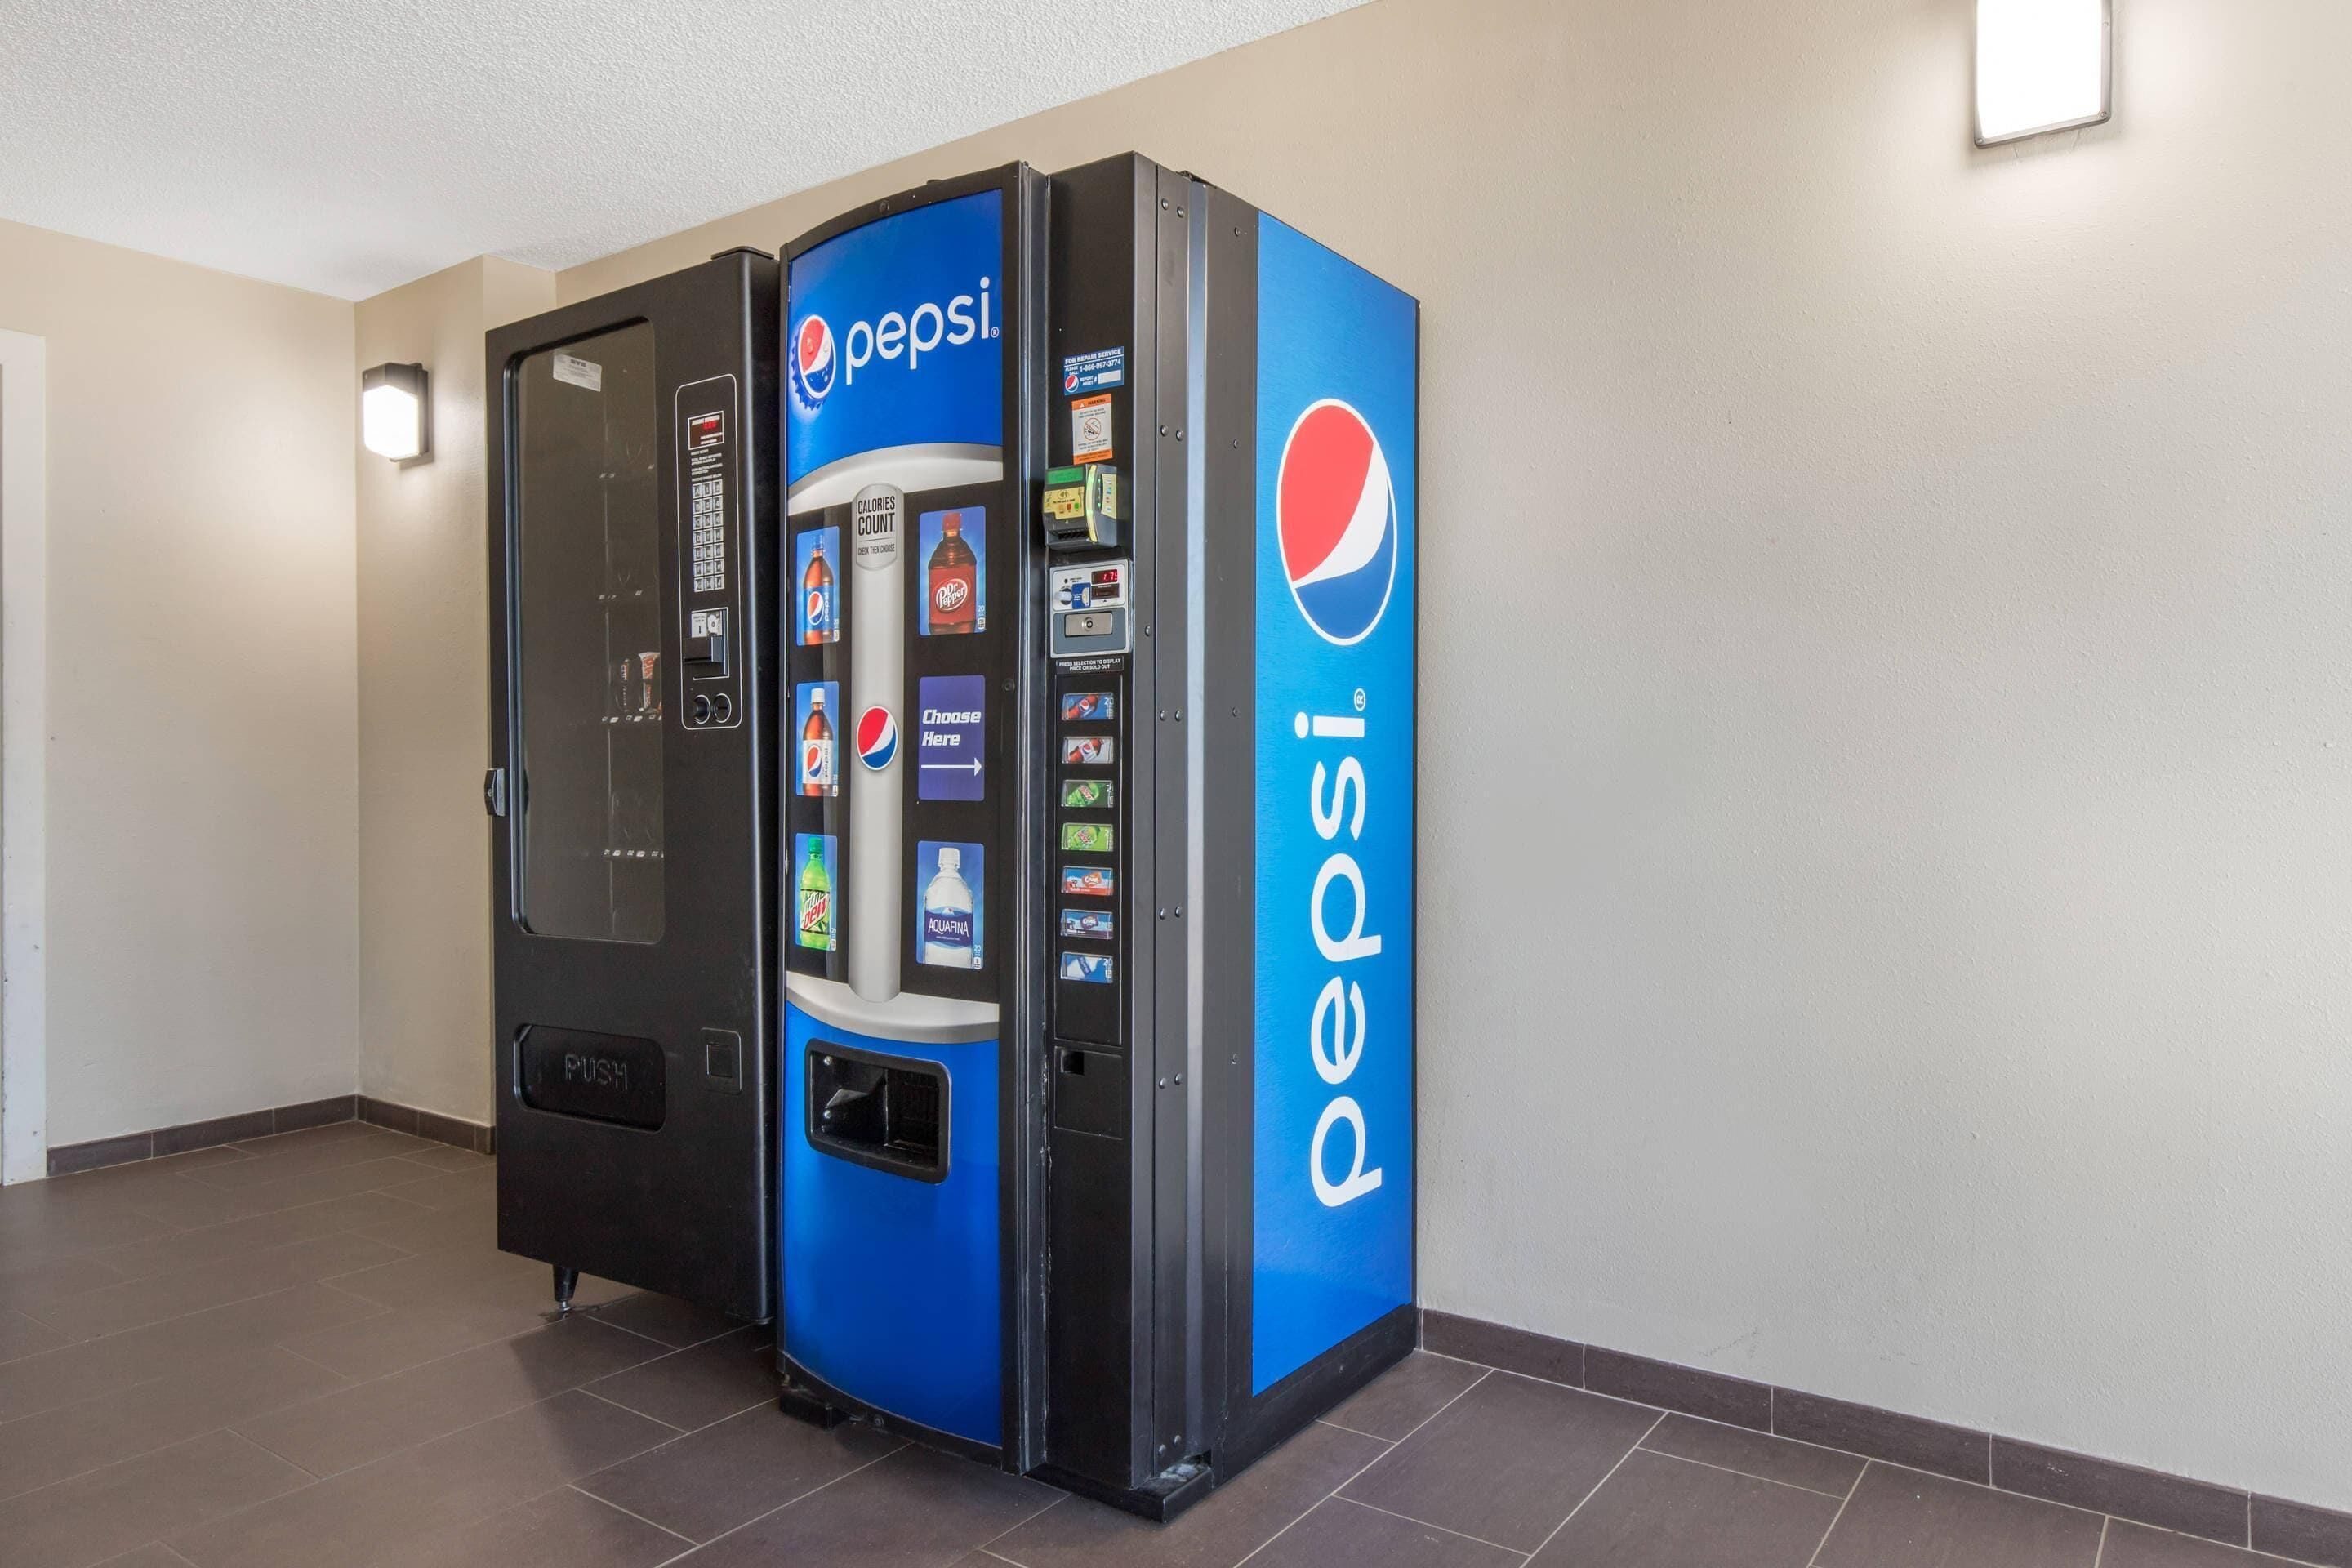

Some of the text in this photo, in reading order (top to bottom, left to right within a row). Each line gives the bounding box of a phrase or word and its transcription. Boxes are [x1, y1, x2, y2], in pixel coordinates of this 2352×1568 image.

[846, 276, 990, 385] pepsi
[1077, 354, 1097, 362] REPAIR
[1098, 348, 1121, 358] SERVICE
[858, 496, 895, 514] CALORIES
[858, 512, 895, 536] COUNT
[858, 543, 895, 555] CHECK THEN CHOOSE
[940, 586, 965, 608] Pepper
[947, 583, 958, 596] Dr
[922, 709, 982, 724] Choose
[921, 731, 960, 746] Here
[928, 918, 969, 938] AQUAFINA
[1294, 711, 1382, 1208] pepsi
[564, 1054, 627, 1092] PUSH
